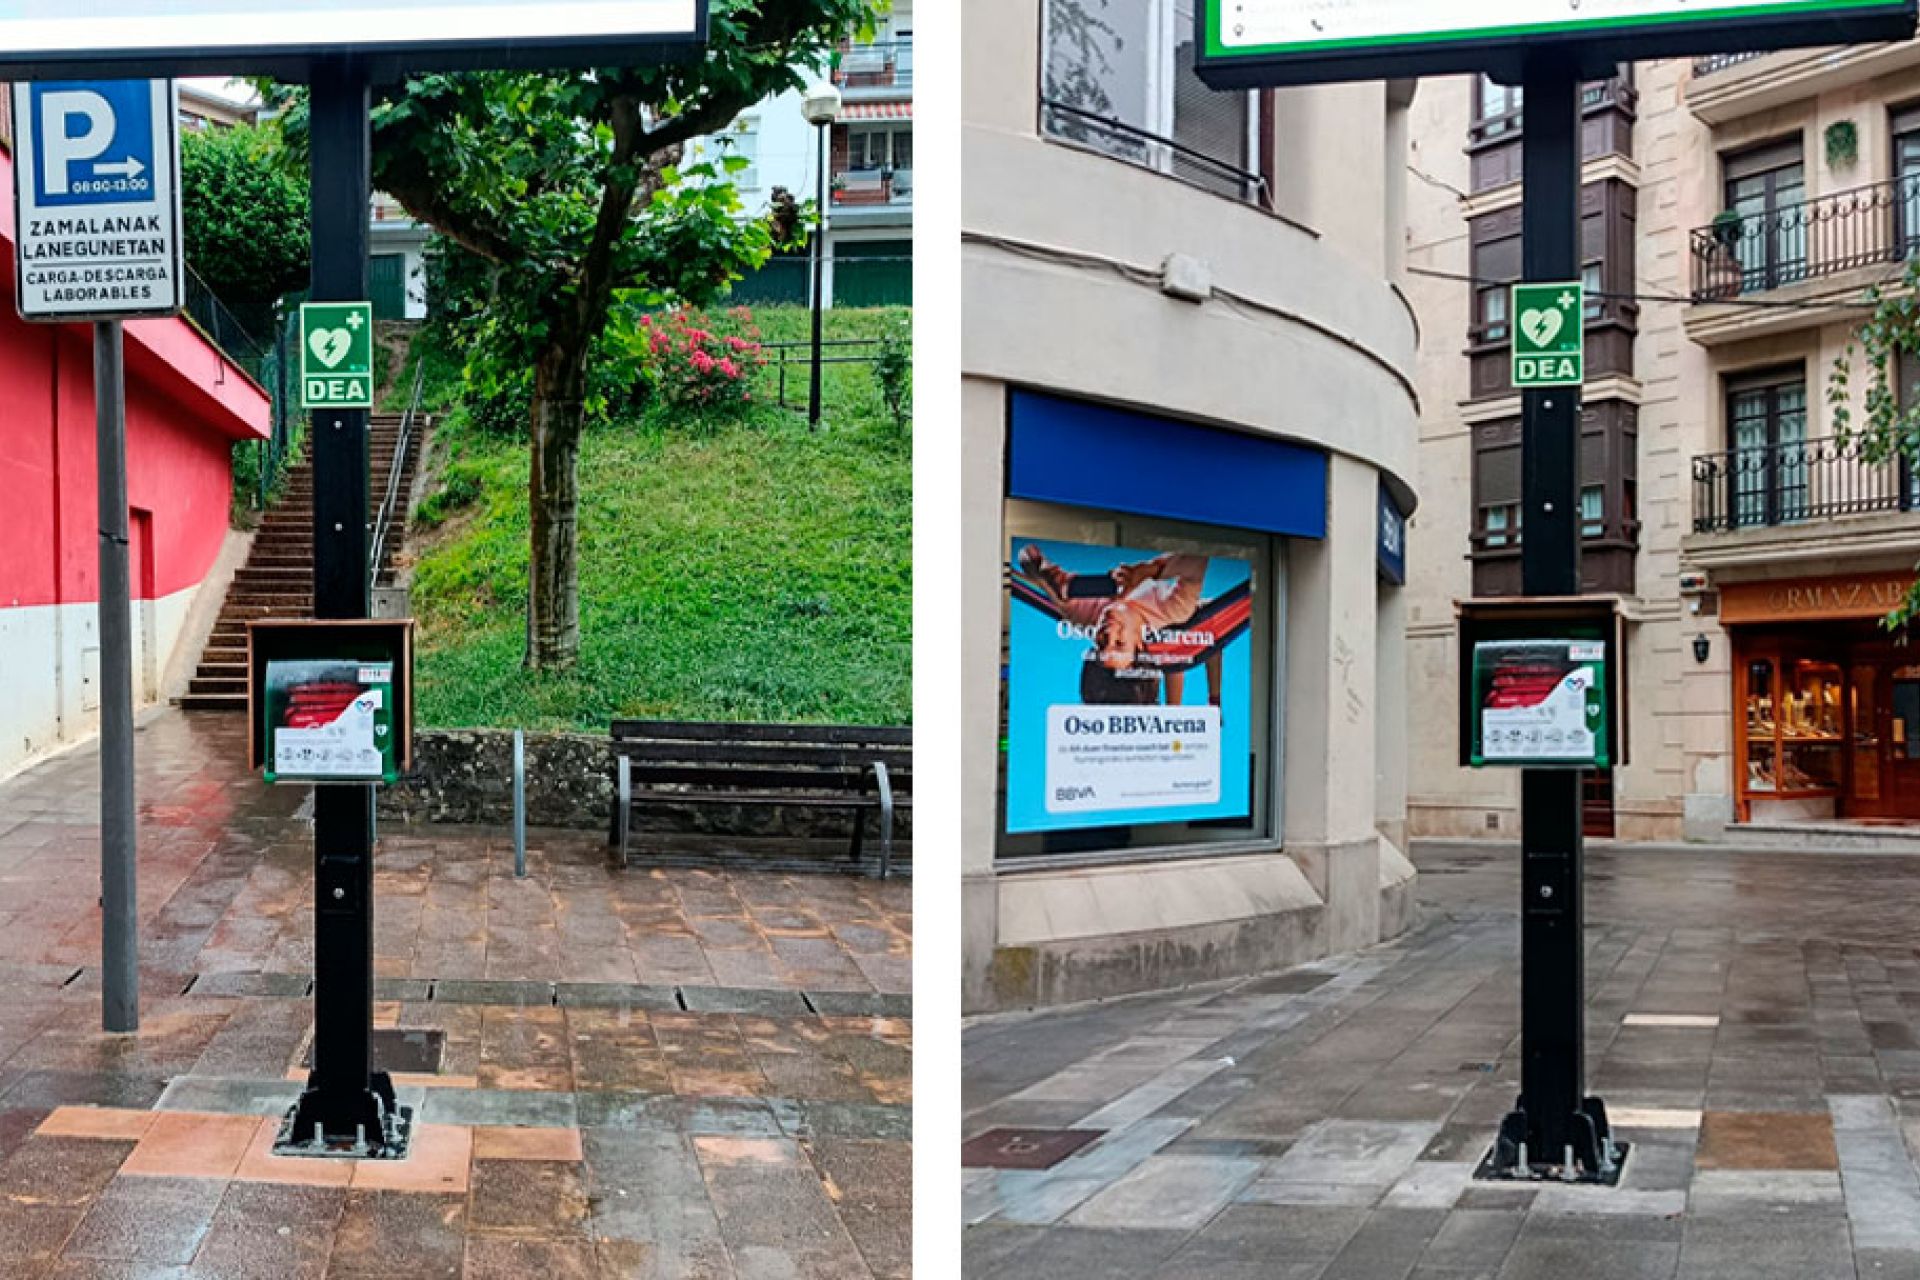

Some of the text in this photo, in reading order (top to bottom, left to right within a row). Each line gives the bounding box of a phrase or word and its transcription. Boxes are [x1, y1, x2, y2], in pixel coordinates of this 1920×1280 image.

[41, 90, 116, 194] P
[30, 214, 160, 237] ZAMALANAK
[23, 237, 165, 260] LANEGUNETAN
[26, 266, 168, 285] CARGA-DESCARGA
[43, 285, 152, 303] LABORABLES
[1518, 357, 1576, 379] DEA
[307, 379, 366, 401] DEA
[1064, 713, 1207, 736] Oso BBVArena
[1055, 785, 1096, 801] BBVA
